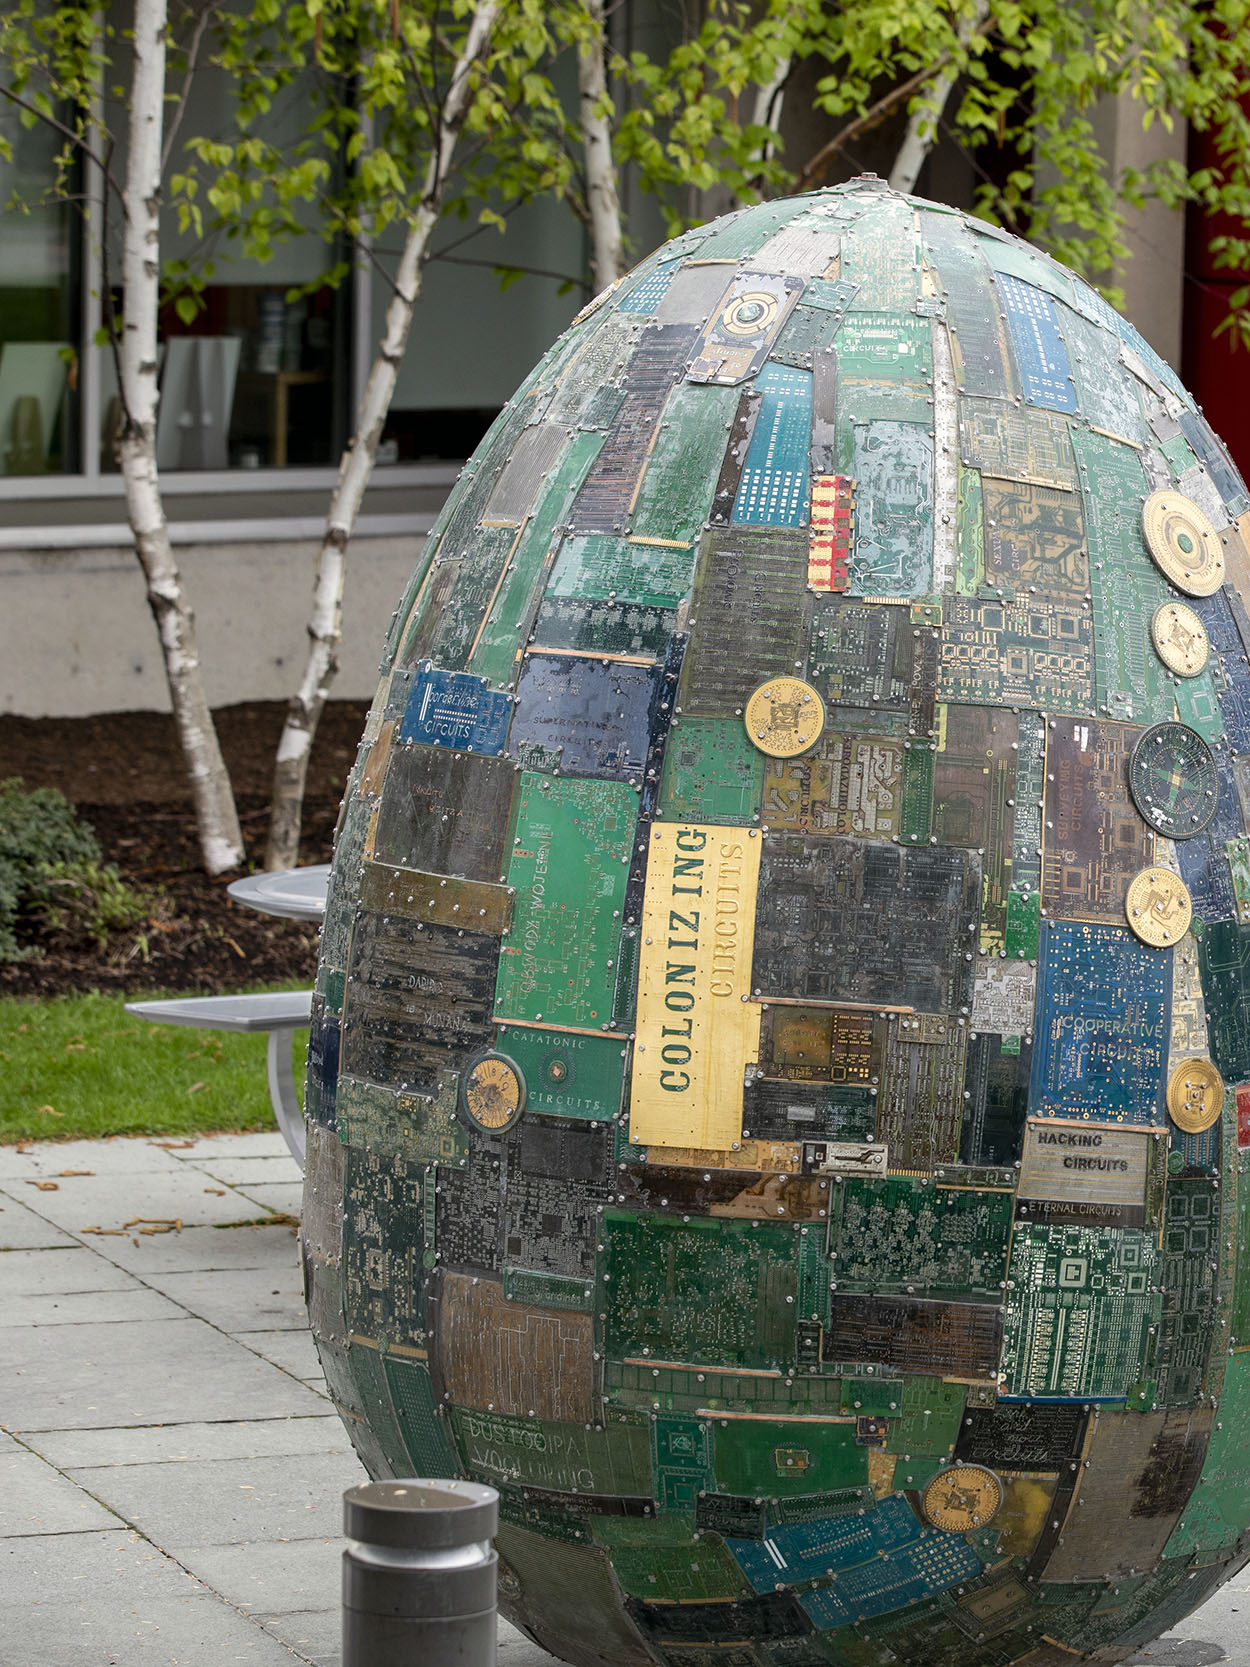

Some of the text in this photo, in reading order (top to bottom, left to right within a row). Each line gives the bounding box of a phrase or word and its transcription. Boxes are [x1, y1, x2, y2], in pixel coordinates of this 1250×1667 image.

[710, 841, 744, 998] CIRCUITS
[659, 827, 708, 1093] COLONIZING
[1062, 1016, 1163, 1039] COOPERATIVE
[512, 1031, 586, 1050] CATATONIC
[528, 1090, 601, 1111] CIRCUITS
[1037, 1132, 1103, 1147] HACKING
[1063, 1157, 1129, 1172] CIRCUITS
[1028, 1201, 1123, 1217] ETERNAL CIRCUITS
